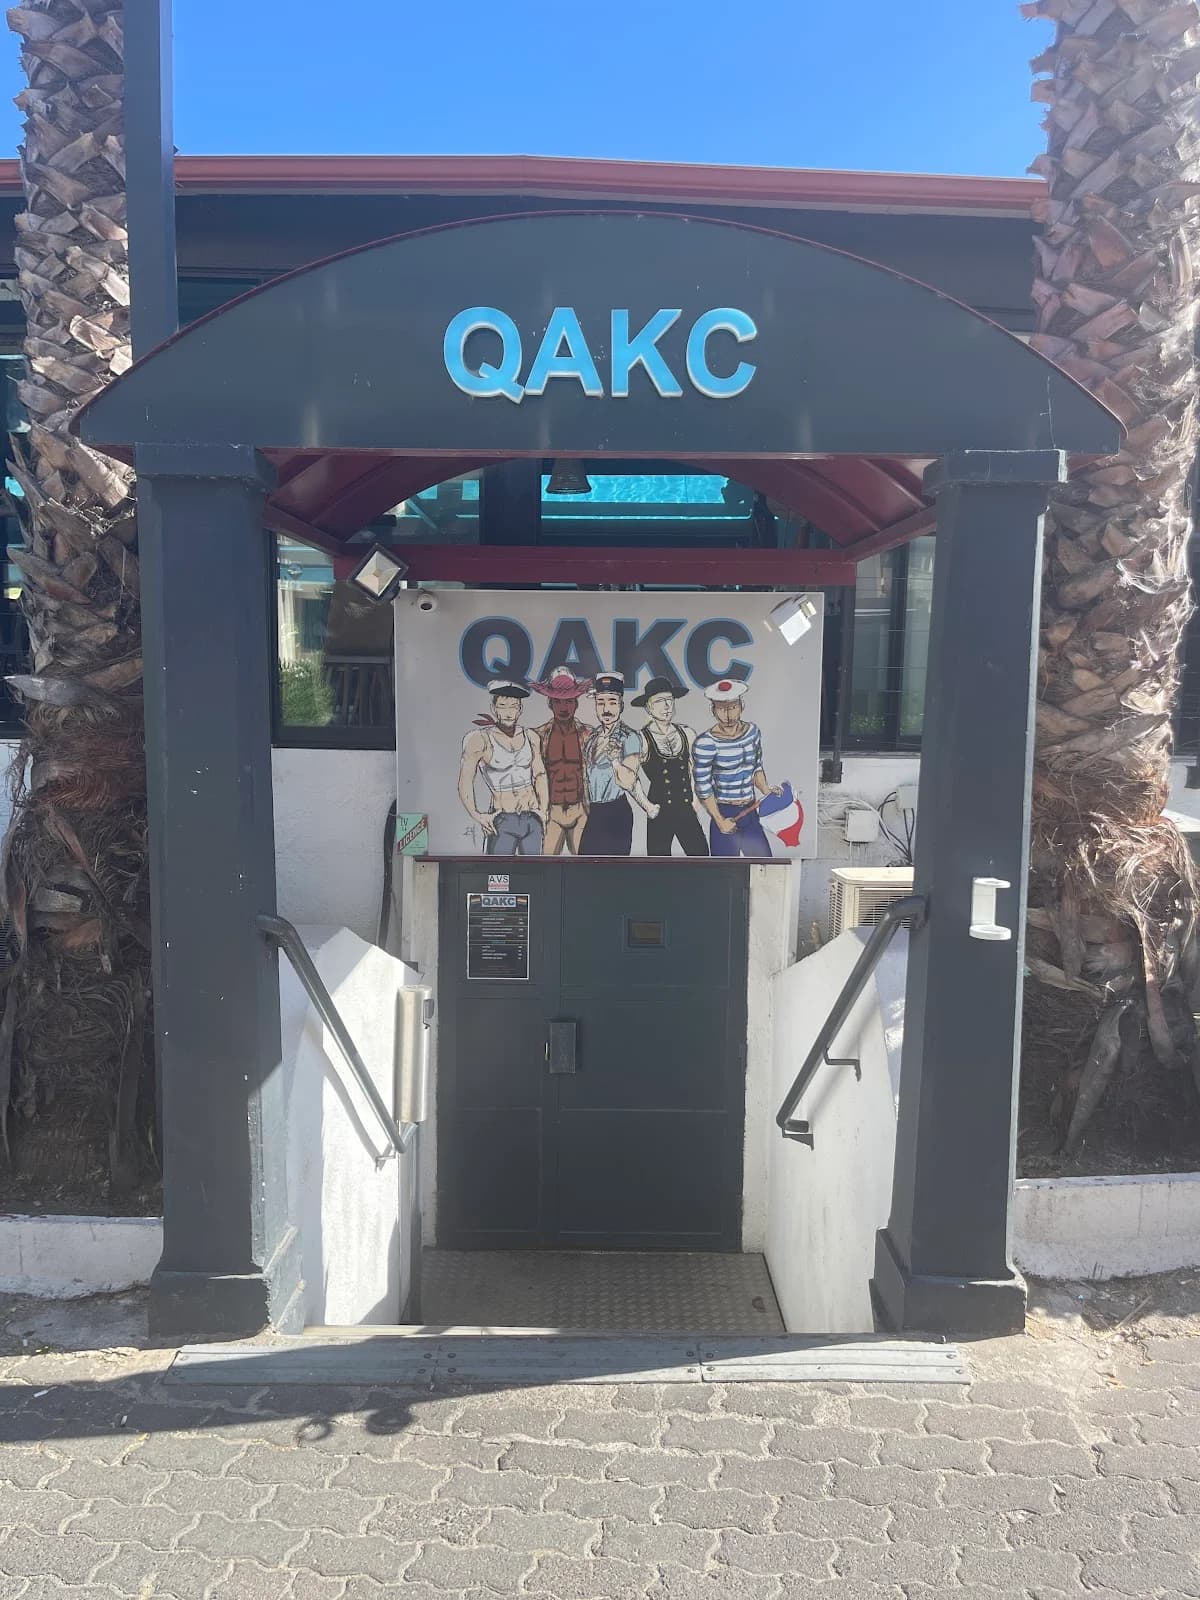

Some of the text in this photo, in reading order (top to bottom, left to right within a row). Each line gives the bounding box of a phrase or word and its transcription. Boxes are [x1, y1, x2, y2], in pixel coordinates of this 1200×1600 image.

[444, 306, 757, 404] QAKC
[459, 615, 754, 691] QAKC
[482, 897, 516, 906] QAKC
